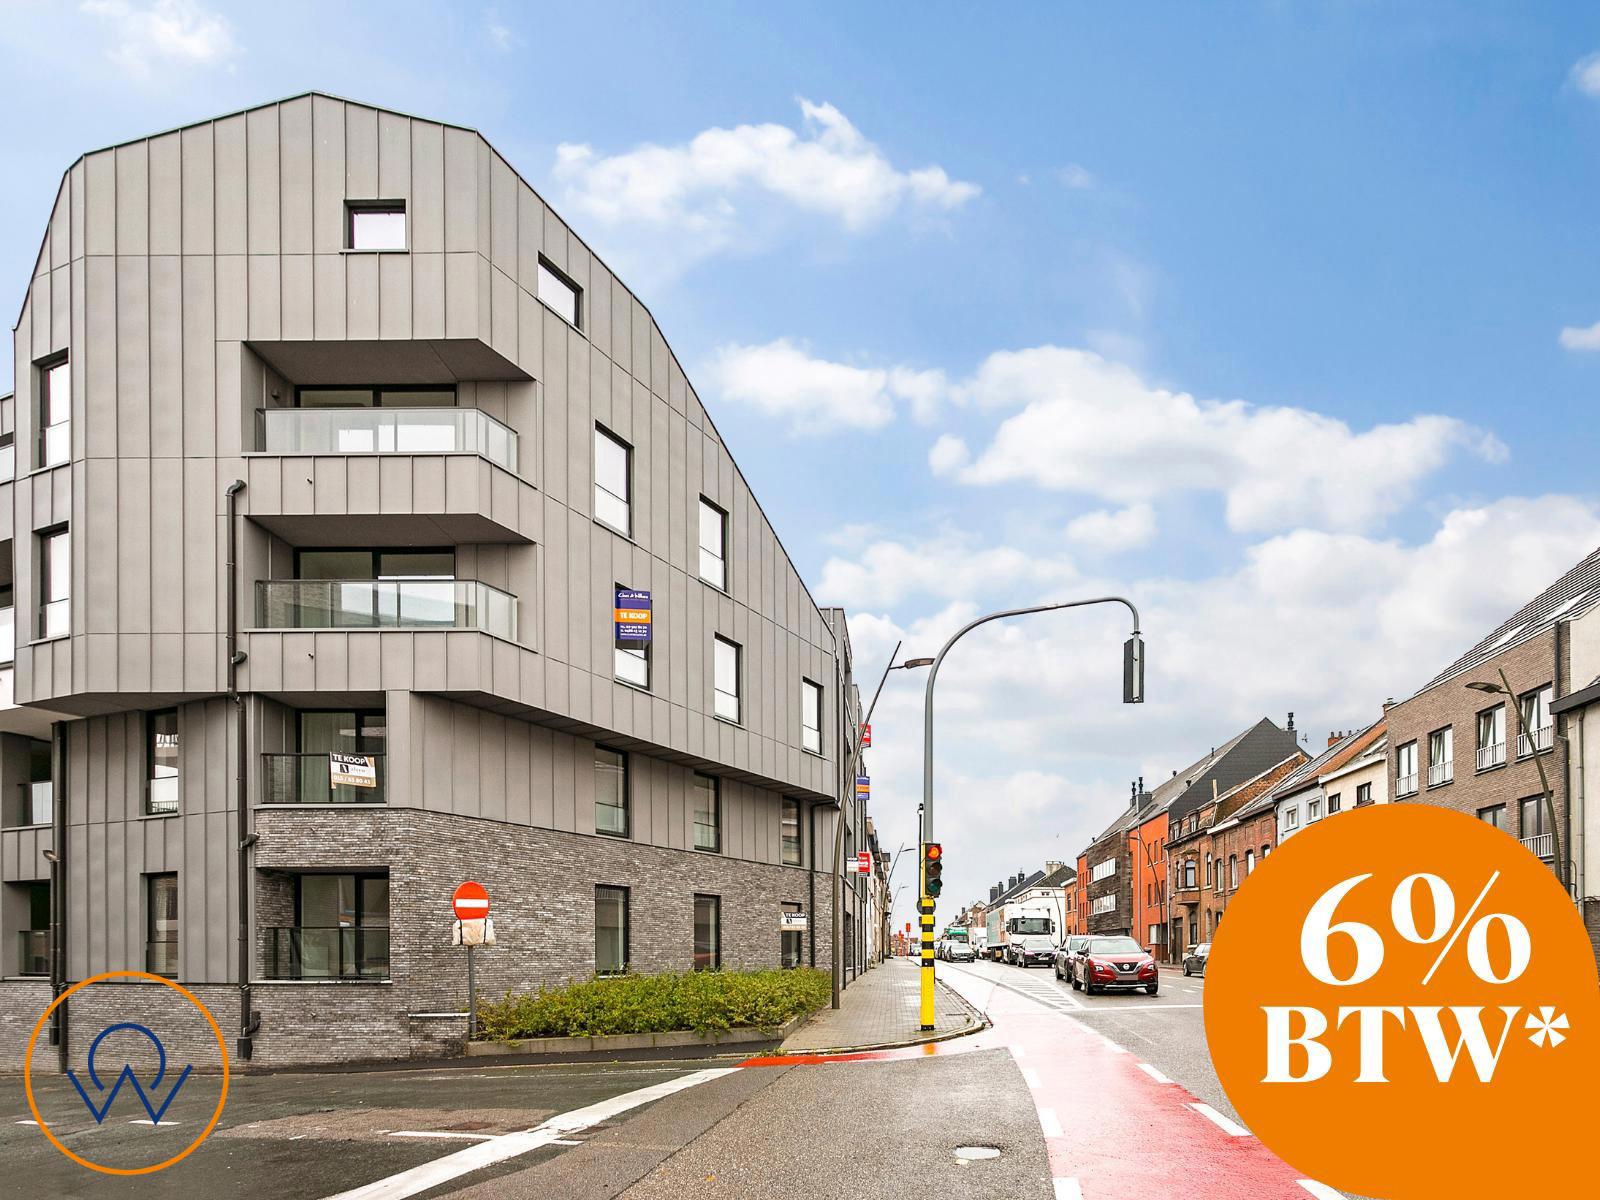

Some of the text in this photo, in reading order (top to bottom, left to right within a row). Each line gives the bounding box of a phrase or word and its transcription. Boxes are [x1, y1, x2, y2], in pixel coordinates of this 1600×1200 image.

[629, 612, 648, 620] KOOP
[332, 753, 366, 765] TE KOOP
